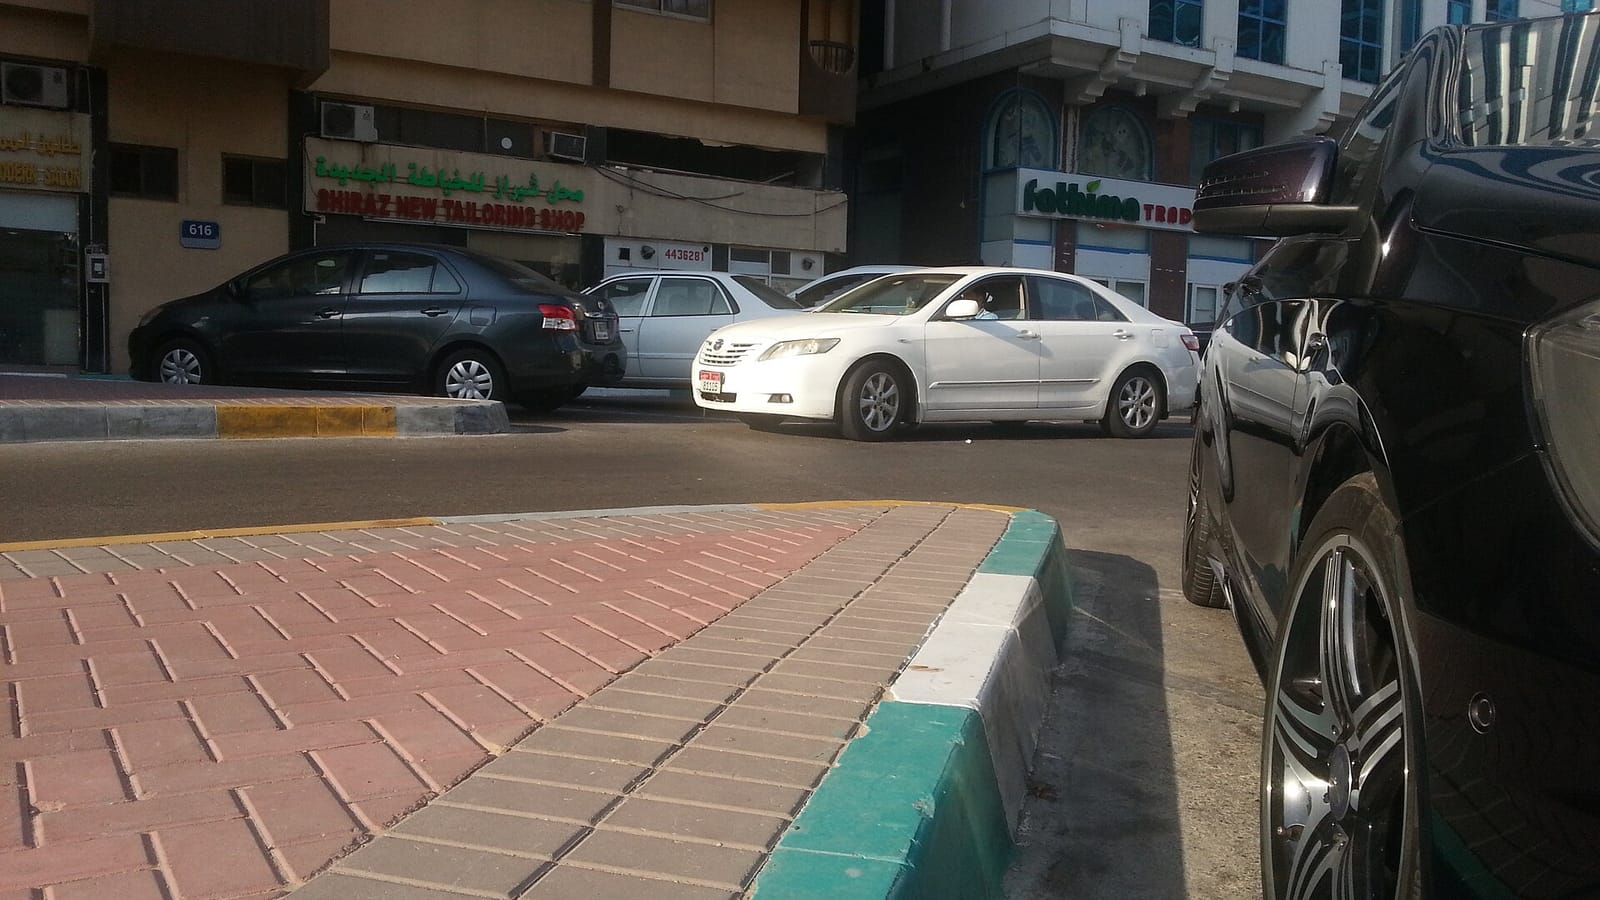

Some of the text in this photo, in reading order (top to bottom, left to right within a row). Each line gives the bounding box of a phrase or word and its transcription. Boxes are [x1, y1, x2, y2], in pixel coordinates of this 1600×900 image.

[315, 155, 585, 205] محل شيراز للخياطة الجديدة
[317, 188, 585, 232] SHIRAZ NEW TAILORING SHOP
[1144, 203, 1193, 225] TRAD
[189, 223, 213, 236] 616
[664, 248, 705, 262] 4436281
